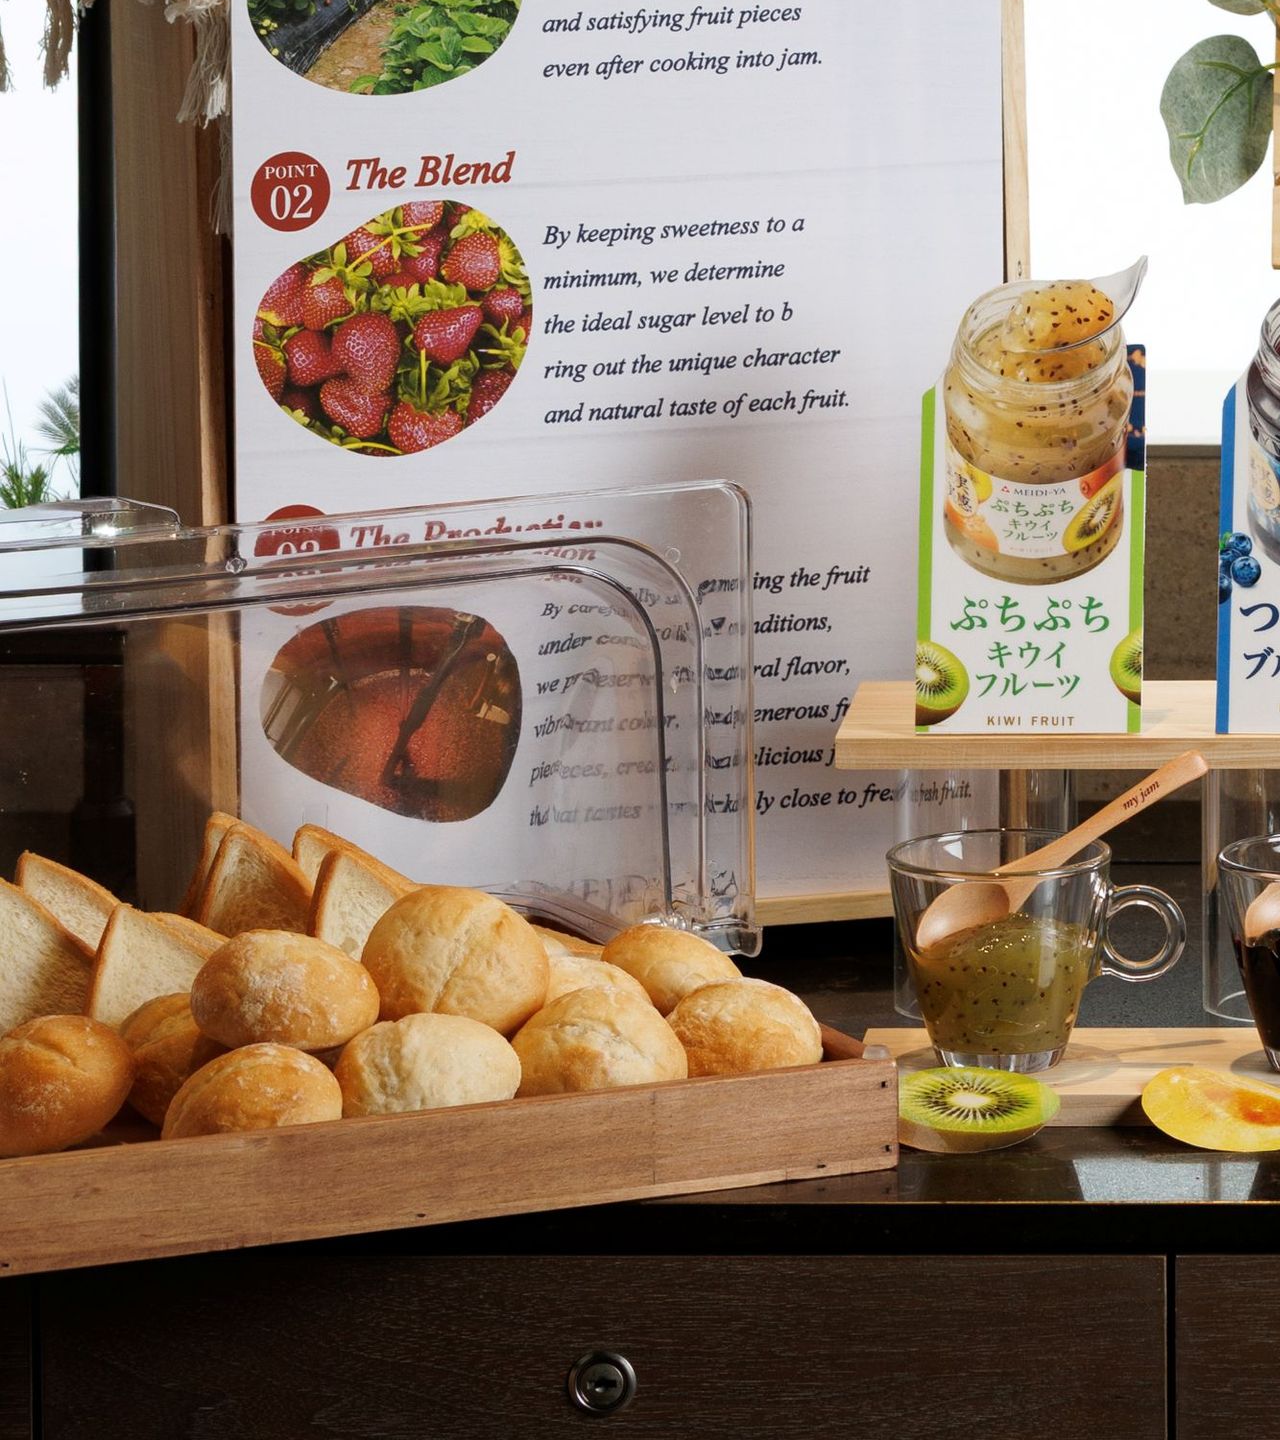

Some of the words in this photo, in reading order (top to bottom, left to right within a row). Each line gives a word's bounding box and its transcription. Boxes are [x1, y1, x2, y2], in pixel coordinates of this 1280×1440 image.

[541, 11, 584, 34] and
[585, 8, 686, 35] satisfying
[684, 5, 735, 32] fruit
[735, 4, 803, 30] pieces
[542, 62, 590, 79] even
[595, 54, 645, 81] after
[648, 50, 732, 75] cooking
[735, 49, 775, 69] into
[775, 47, 823, 72] jam.
[265, 164, 314, 180] POINT
[345, 156, 407, 191] The
[413, 150, 517, 188] Blend
[270, 184, 313, 220] 02
[541, 225, 572, 250] By
[575, 222, 657, 248] keeping
[659, 219, 761, 240] sweetness
[766, 216, 787, 234] to
[791, 217, 806, 233] a
[543, 269, 642, 290] minimum,
[649, 269, 679, 284] we
[683, 259, 786, 283] determine
[544, 313, 576, 335] the
[581, 309, 633, 333] ideal
[636, 312, 697, 334] sugar
[701, 303, 751, 326] level
[754, 306, 775, 324] to
[780, 300, 794, 322] b
[543, 359, 589, 383] ring
[592, 358, 627, 377] out
[631, 353, 663, 375] the
[668, 351, 738, 376] unique
[742, 347, 842, 369] character
[543, 401, 585, 425] and
[587, 397, 665, 422] natural
[668, 398, 718, 418] taste
[722, 392, 749, 419] of
[748, 390, 797, 413] each
[796, 388, 850, 416] fruit.
[949, 595, 1110, 634] ぷちぷち
[987, 641, 1067, 669] キウイ
[975, 672, 1081, 699] フルーツ
[987, 715, 1021, 726] KIWI
[1031, 716, 1075, 727] FRUIT
[1121, 791, 1143, 812] my
[1139, 778, 1162, 802] jam
